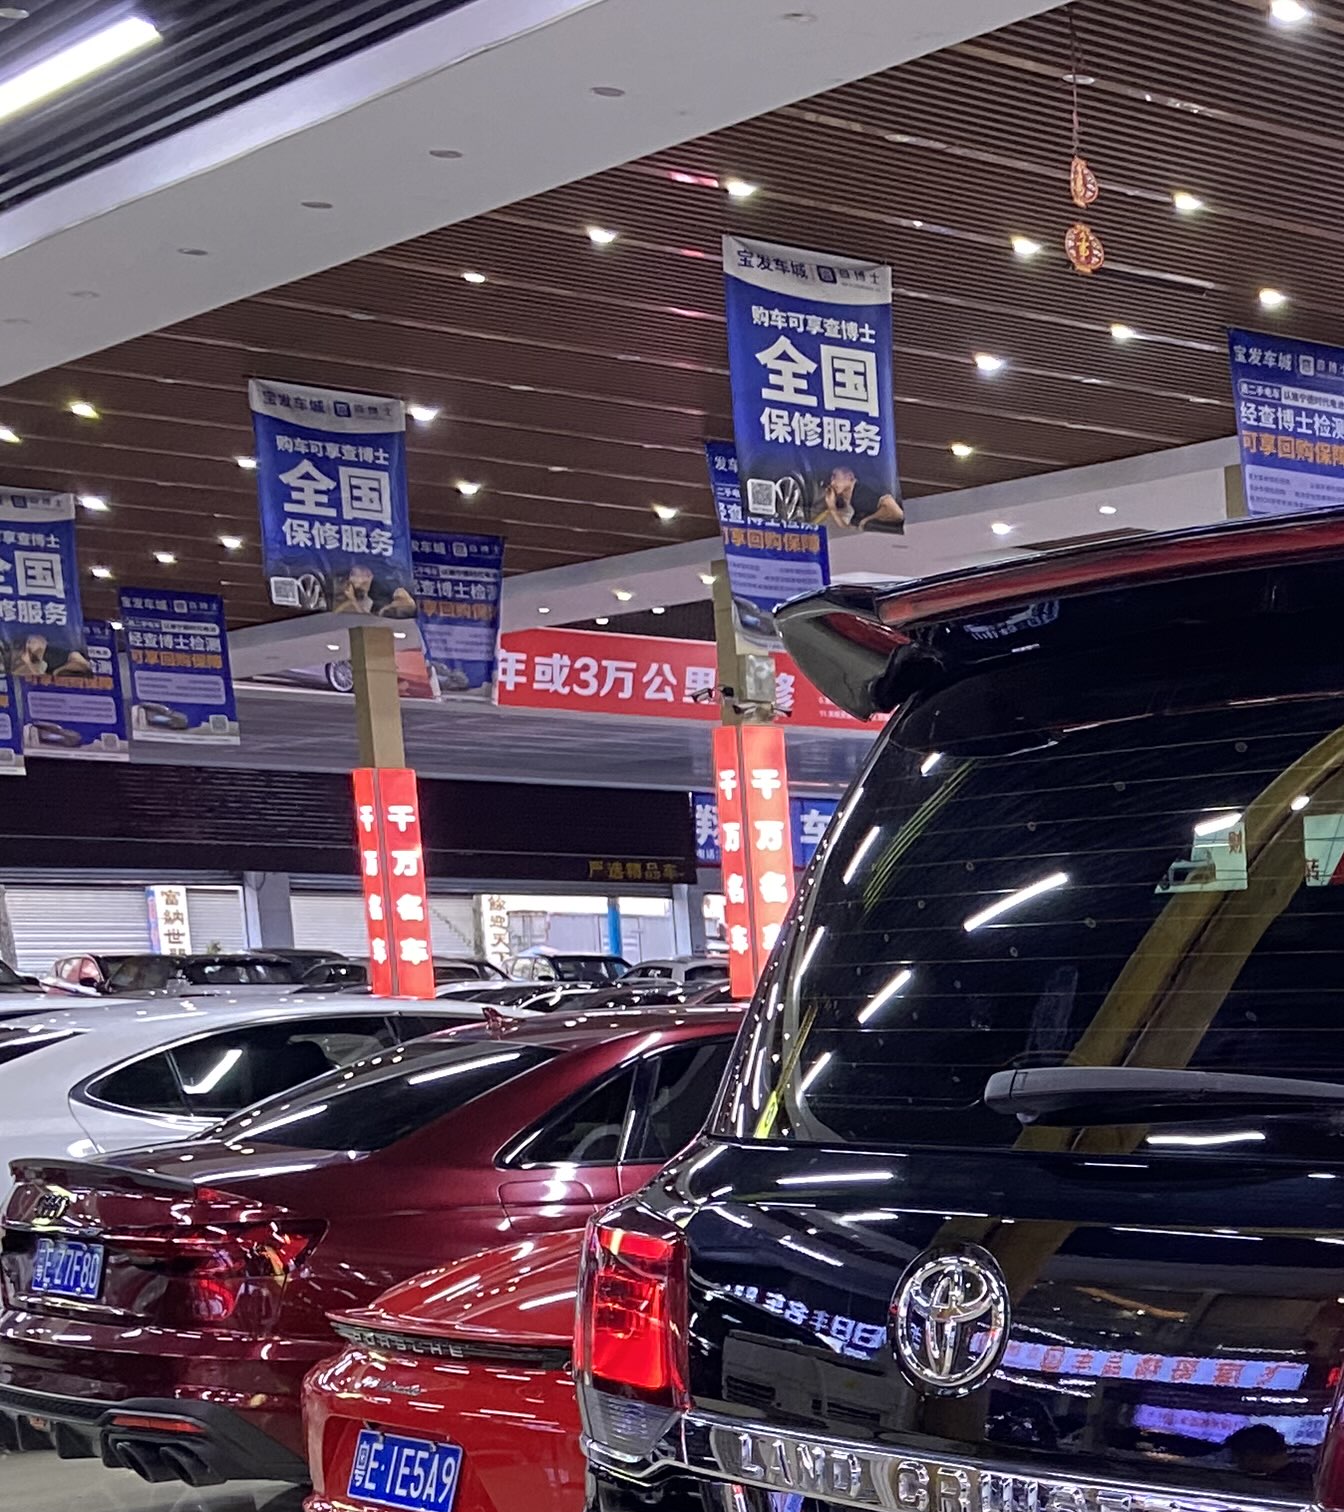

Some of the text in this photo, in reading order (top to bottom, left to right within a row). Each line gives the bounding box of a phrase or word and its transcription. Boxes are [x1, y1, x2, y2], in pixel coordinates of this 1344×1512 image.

[737, 249, 809, 280] 宝发车城
[751, 305, 877, 345] 购车可享查博士
[755, 335, 880, 417] 全国
[276, 435, 390, 466] 购车可享查博士
[760, 407, 881, 457] 保修服务
[279, 459, 393, 525] 全国
[0, 531, 60, 549] 享查博士
[282, 518, 394, 557] 保修服务
[739, 1431, 862, 1497] LAND
